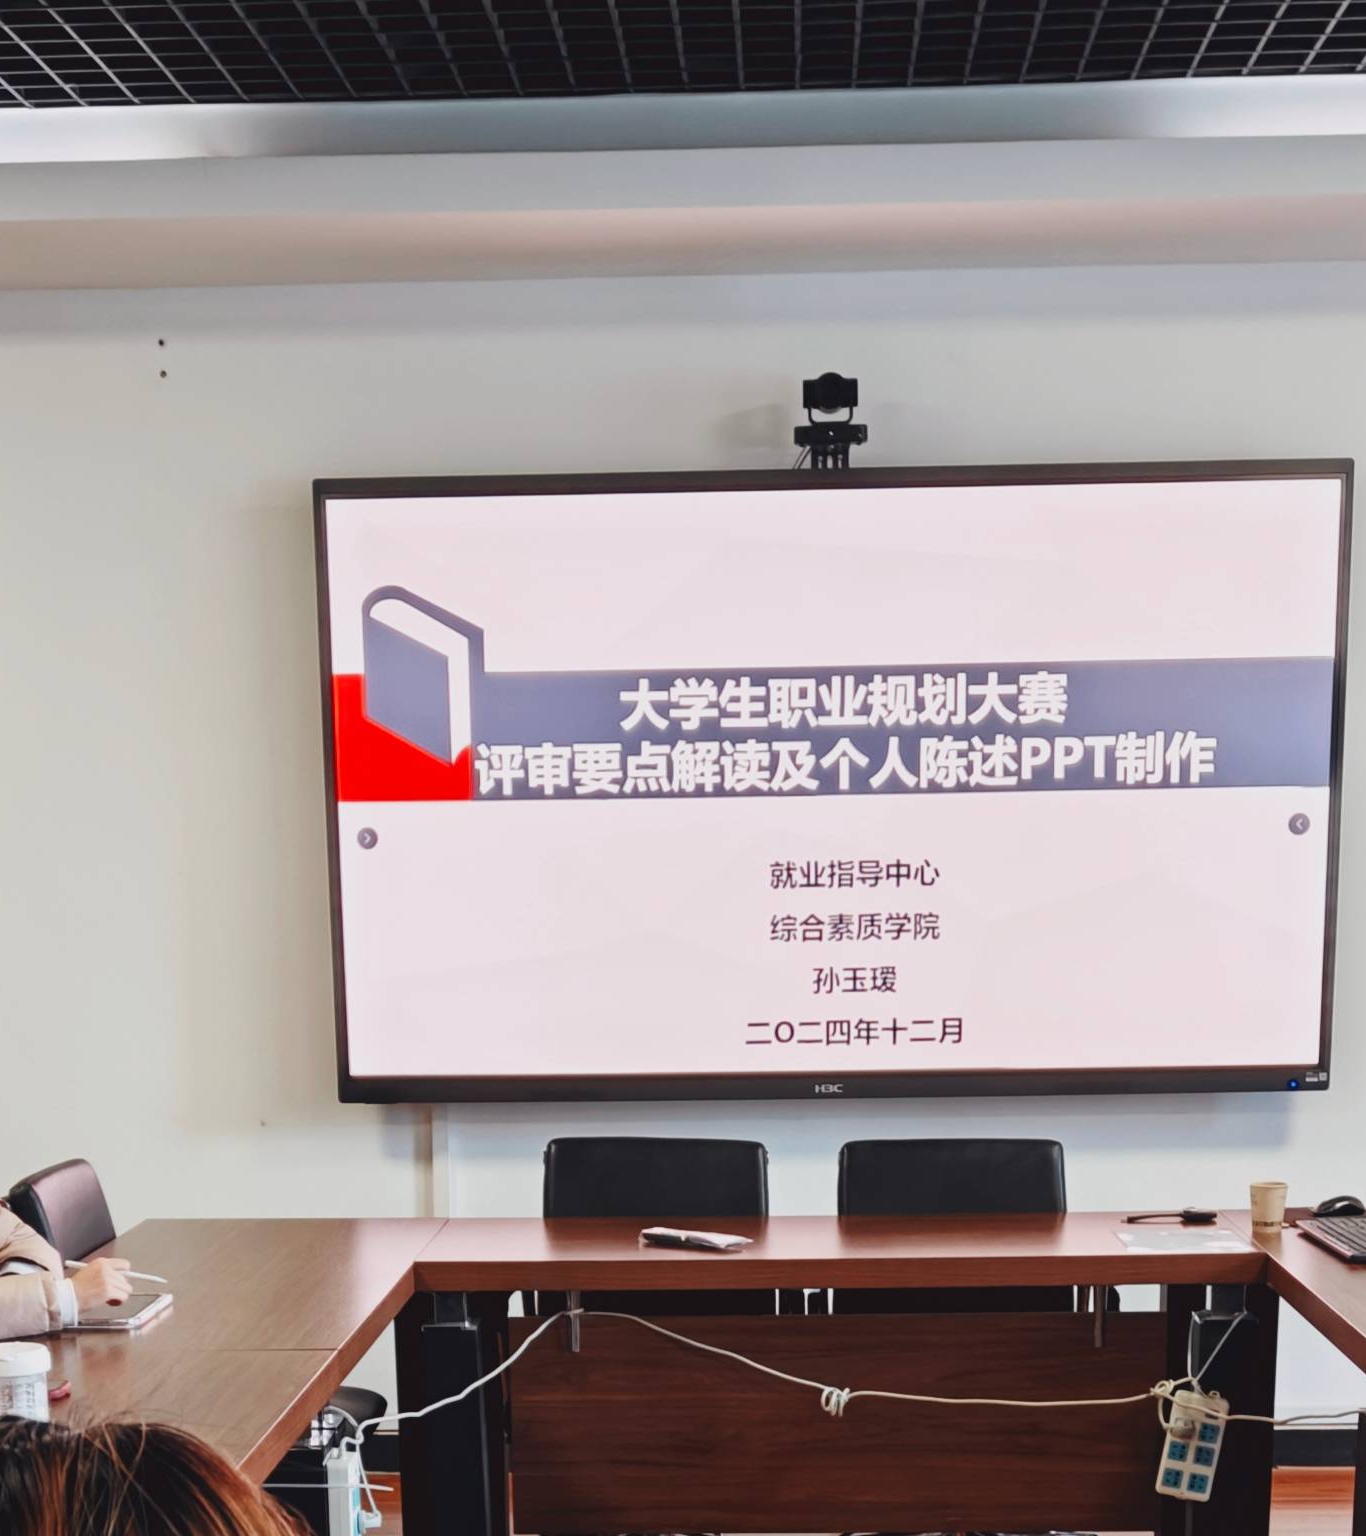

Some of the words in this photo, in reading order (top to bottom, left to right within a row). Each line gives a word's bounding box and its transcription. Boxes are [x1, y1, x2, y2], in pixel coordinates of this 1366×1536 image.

[619, 670, 1069, 731] 大学生职业规划大赛
[475, 730, 1218, 796] 评审要点解读及个人陈述PPT制作
[769, 859, 940, 889] 就业指导中心
[769, 912, 941, 942] 综合素质学院
